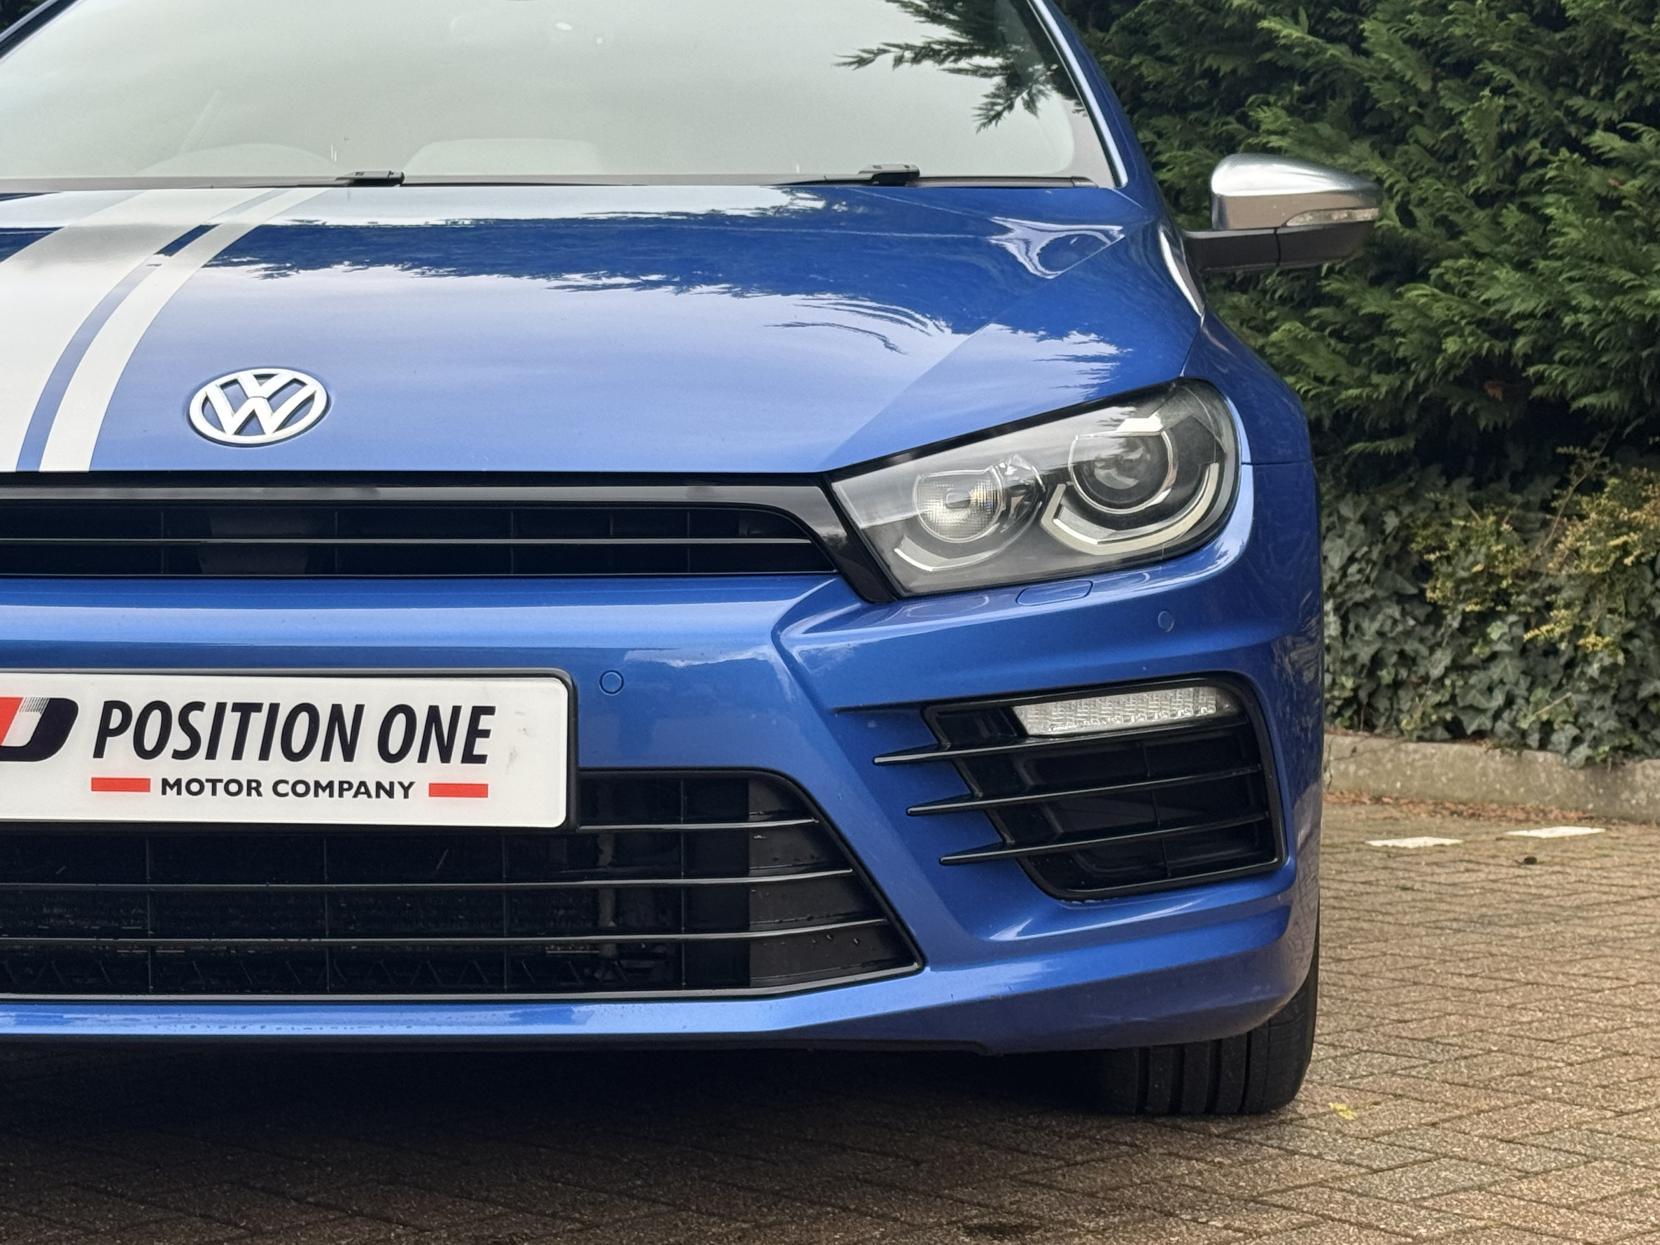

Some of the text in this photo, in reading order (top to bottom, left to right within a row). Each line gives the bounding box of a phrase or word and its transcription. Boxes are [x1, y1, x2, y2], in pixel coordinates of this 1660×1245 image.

[93, 699, 366, 763] POSITION
[378, 703, 496, 765] ONE
[161, 777, 415, 800] MOTOR COMPANY
